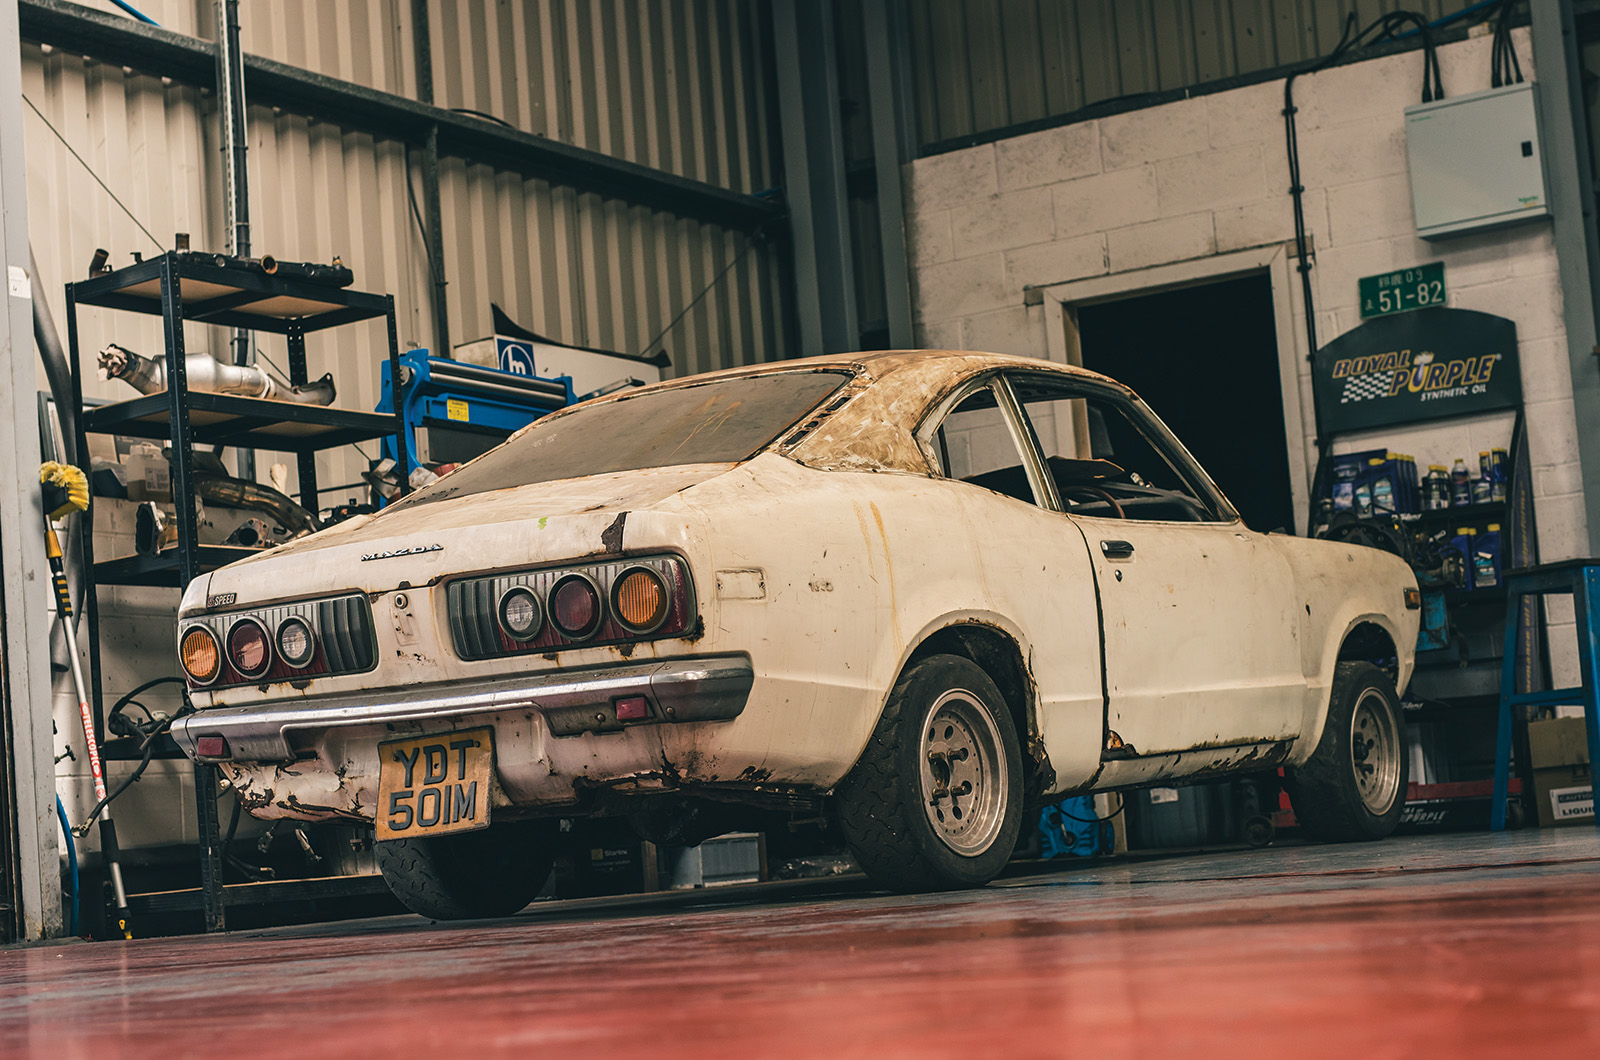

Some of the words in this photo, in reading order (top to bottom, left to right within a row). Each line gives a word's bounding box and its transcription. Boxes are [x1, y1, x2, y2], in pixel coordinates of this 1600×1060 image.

[1379, 281, 1443, 313] 51-82
[1332, 349, 1411, 379] ROYAL
[1388, 353, 1496, 397] PURPLE
[1420, 386, 1469, 402] SYNTHETIC
[1471, 384, 1487, 394] OIL
[360, 543, 444, 561] MAZDA
[214, 594, 235, 607] SPEED
[82, 714, 100, 766] TELESCOPIC
[396, 739, 475, 788] YDT
[388, 781, 478, 831] 501M
[1560, 792, 1594, 801] CAUTIO
[1562, 806, 1595, 816] LIQUI
